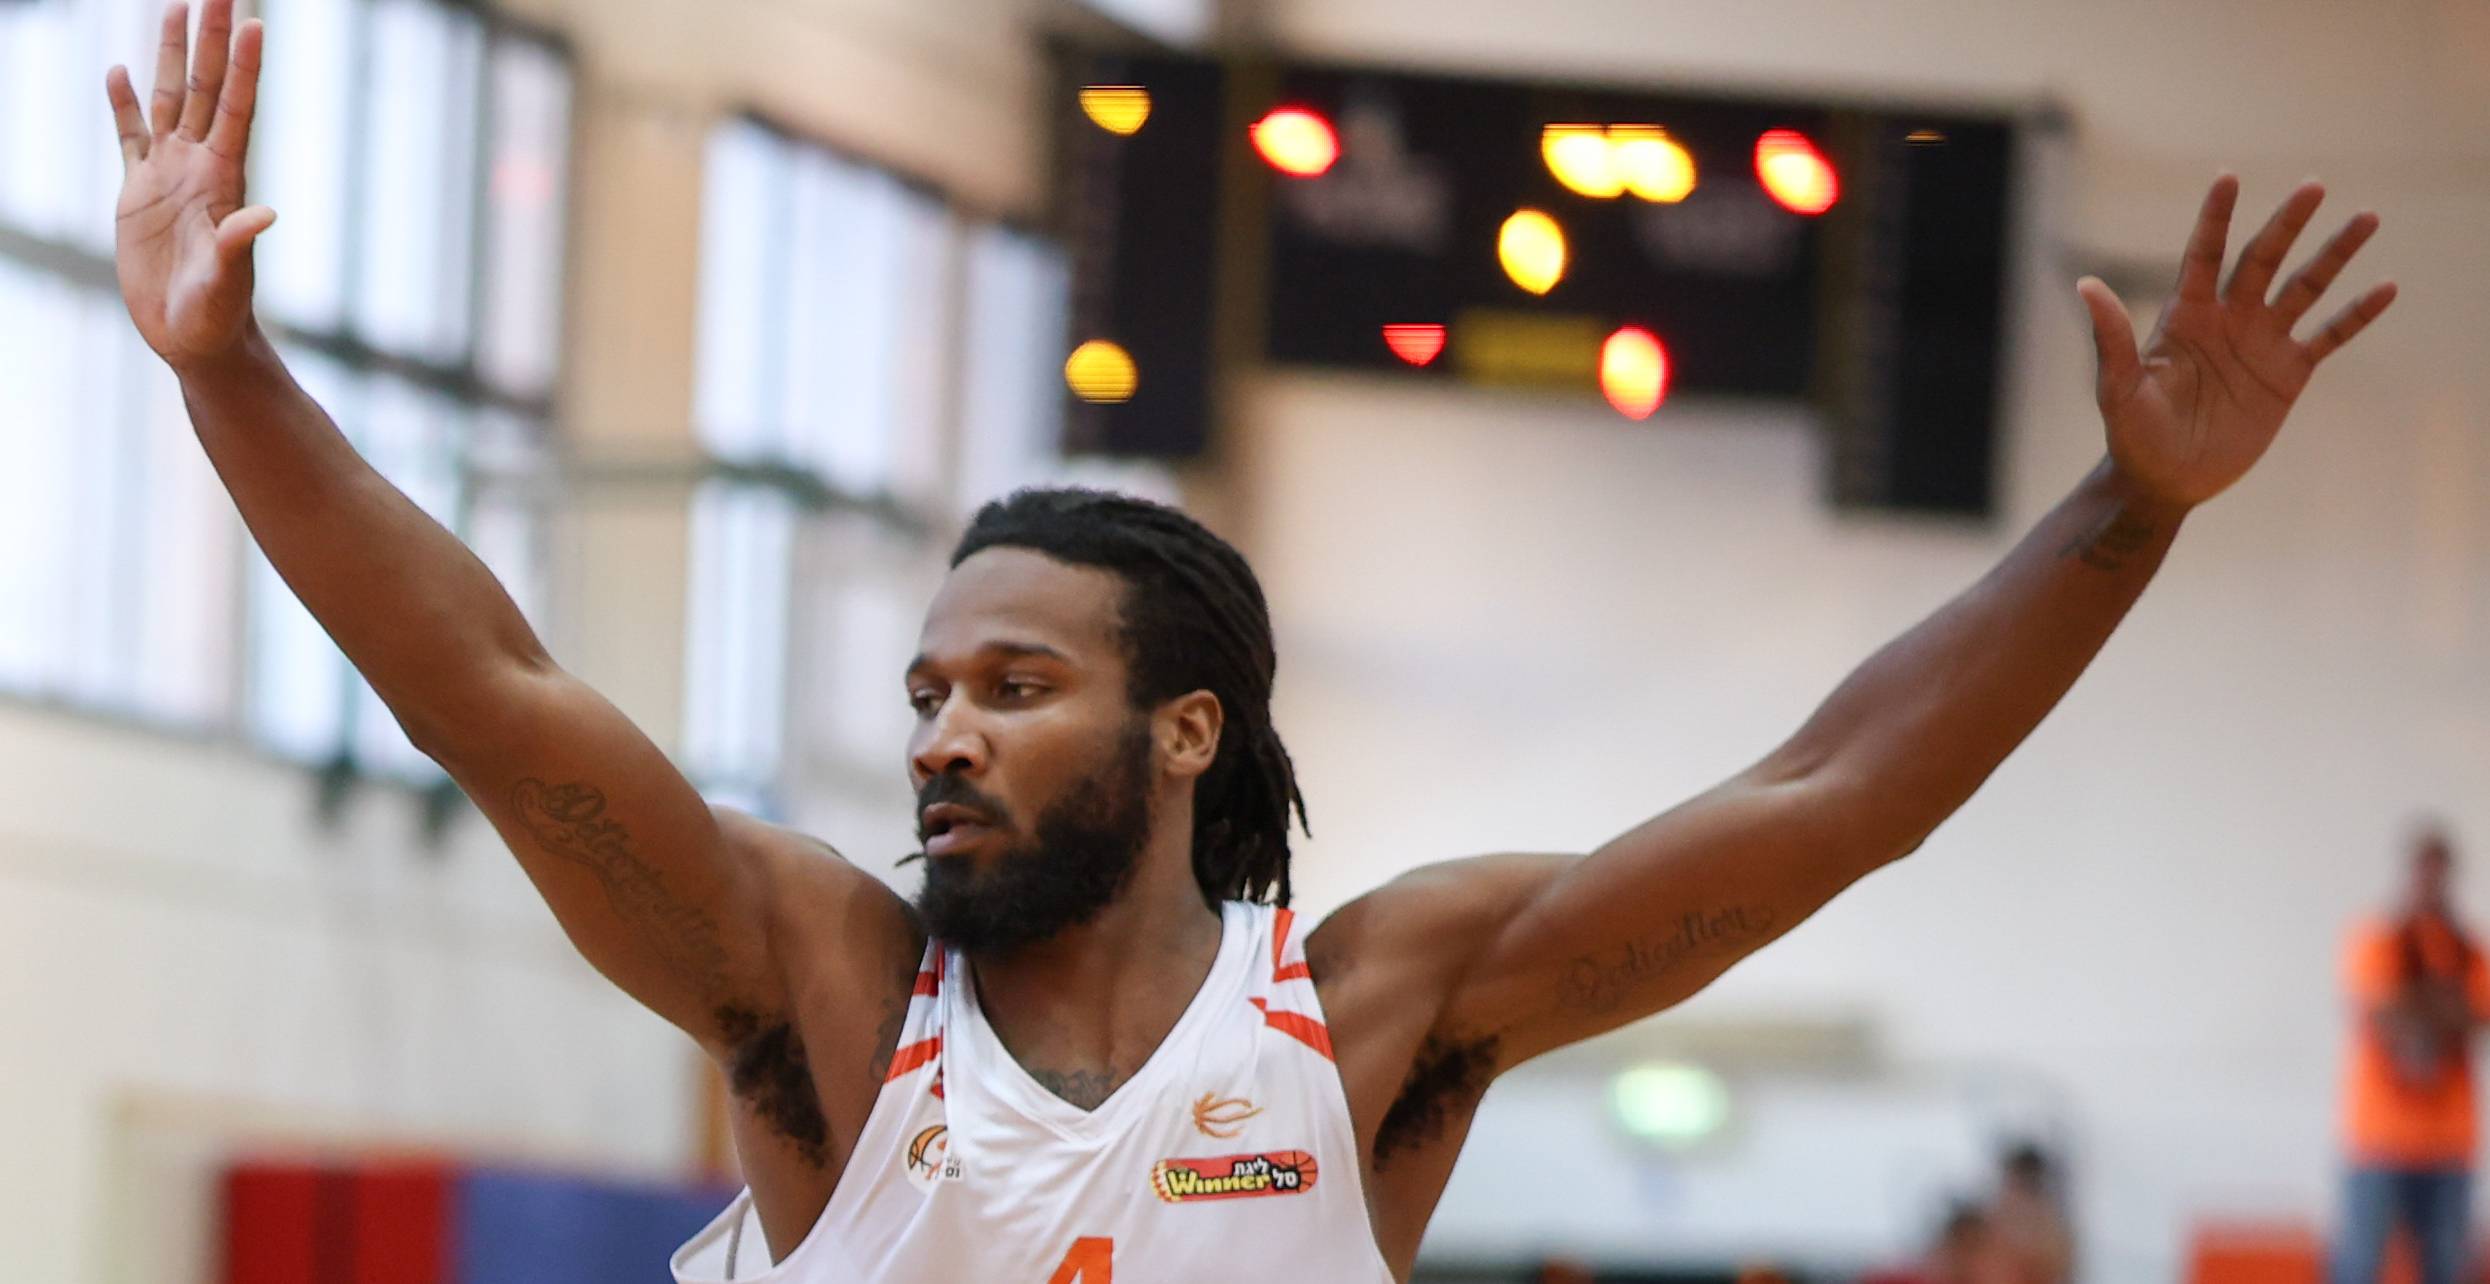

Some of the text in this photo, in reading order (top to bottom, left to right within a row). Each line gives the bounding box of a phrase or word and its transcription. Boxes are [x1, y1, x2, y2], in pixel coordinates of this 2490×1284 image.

[1233, 1156, 1268, 1176] ליגת
[1166, 1169, 1270, 1195] Winner
[1272, 1168, 1299, 1187] סל
